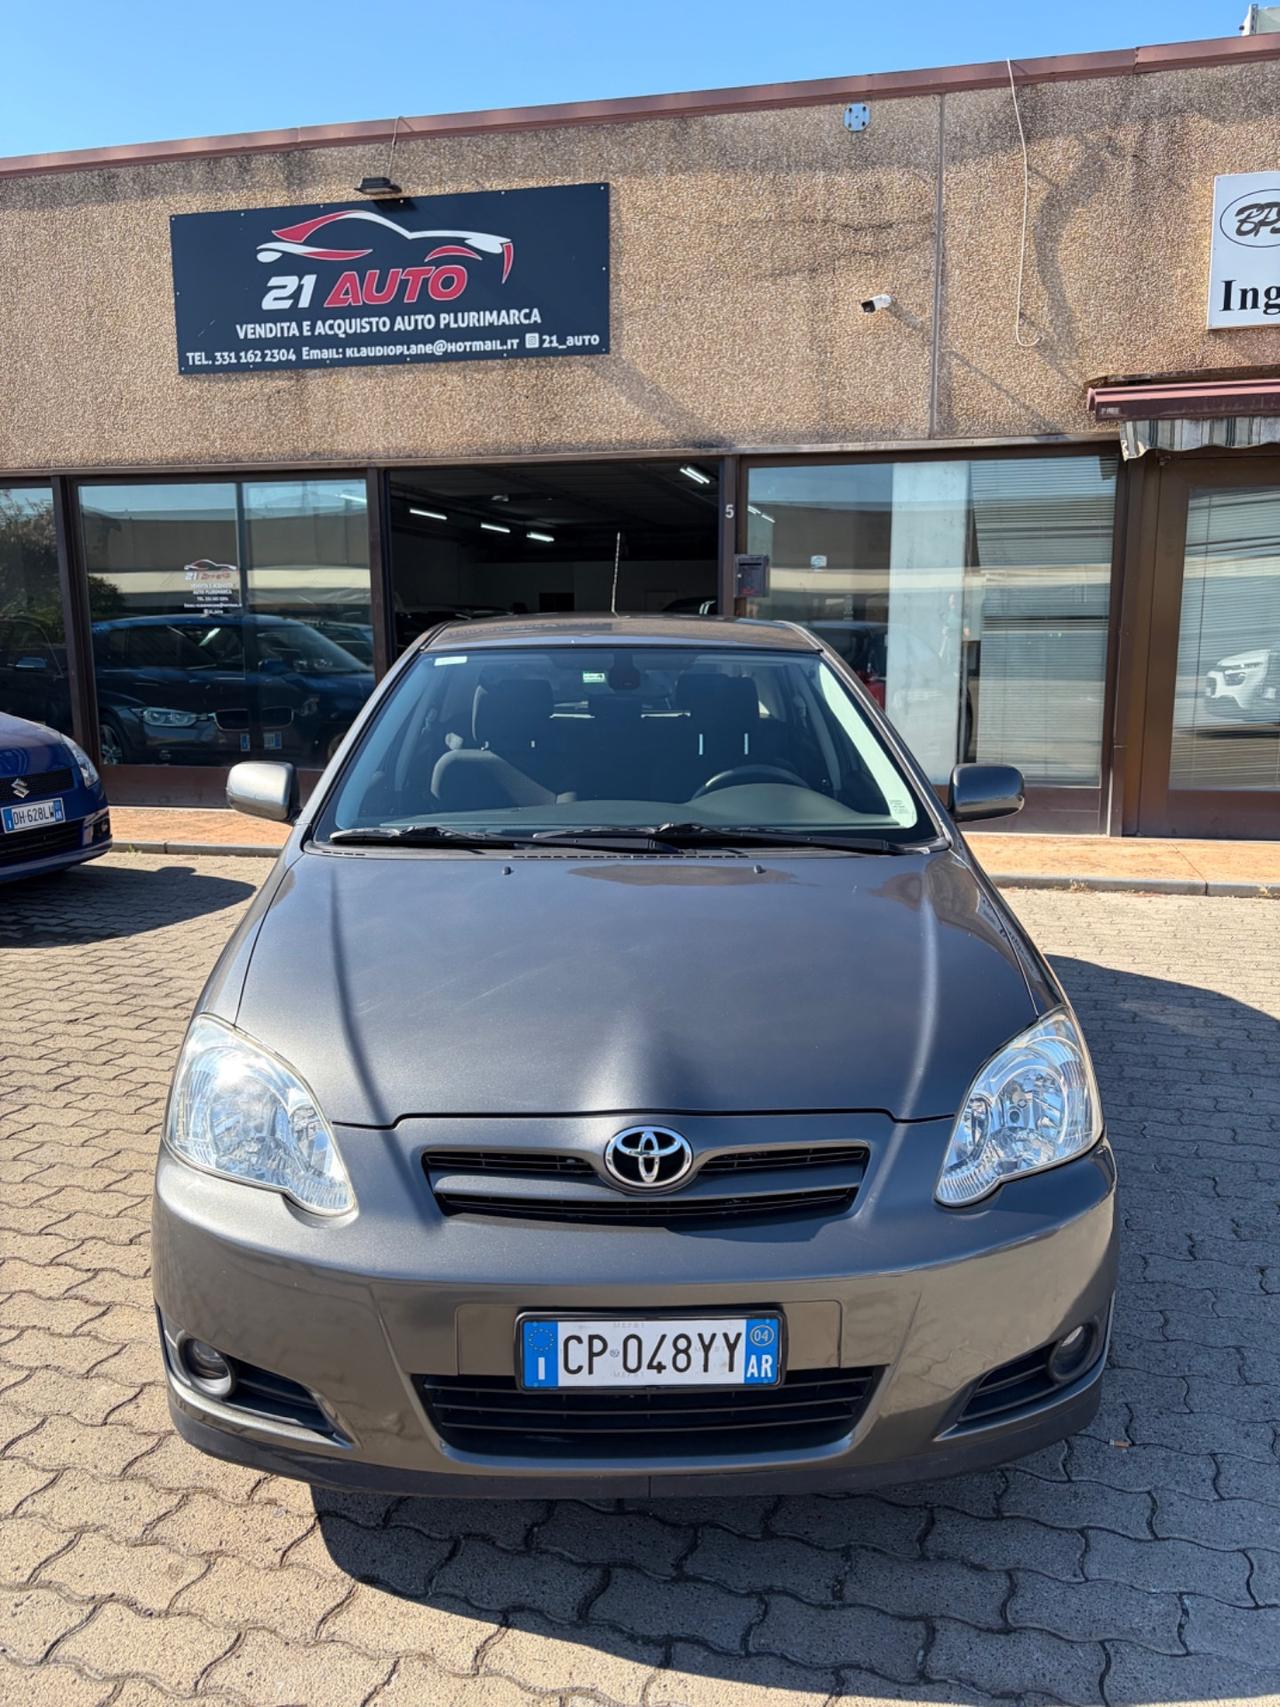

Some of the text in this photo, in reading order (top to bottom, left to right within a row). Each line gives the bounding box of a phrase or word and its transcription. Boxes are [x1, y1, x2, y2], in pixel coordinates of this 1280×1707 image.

[261, 265, 468, 310] 21 AUTO
[236, 308, 542, 339] VENDITA E ACQUISTO AUTO PLURIMARCA
[186, 352, 212, 365] TEL.
[214, 351, 237, 365] 331
[239, 350, 262, 363] 162
[264, 349, 296, 362] 2304
[725, 504, 735, 518] 5
[754, 1329, 769, 1342] 04
[746, 1354, 773, 1378] AR
